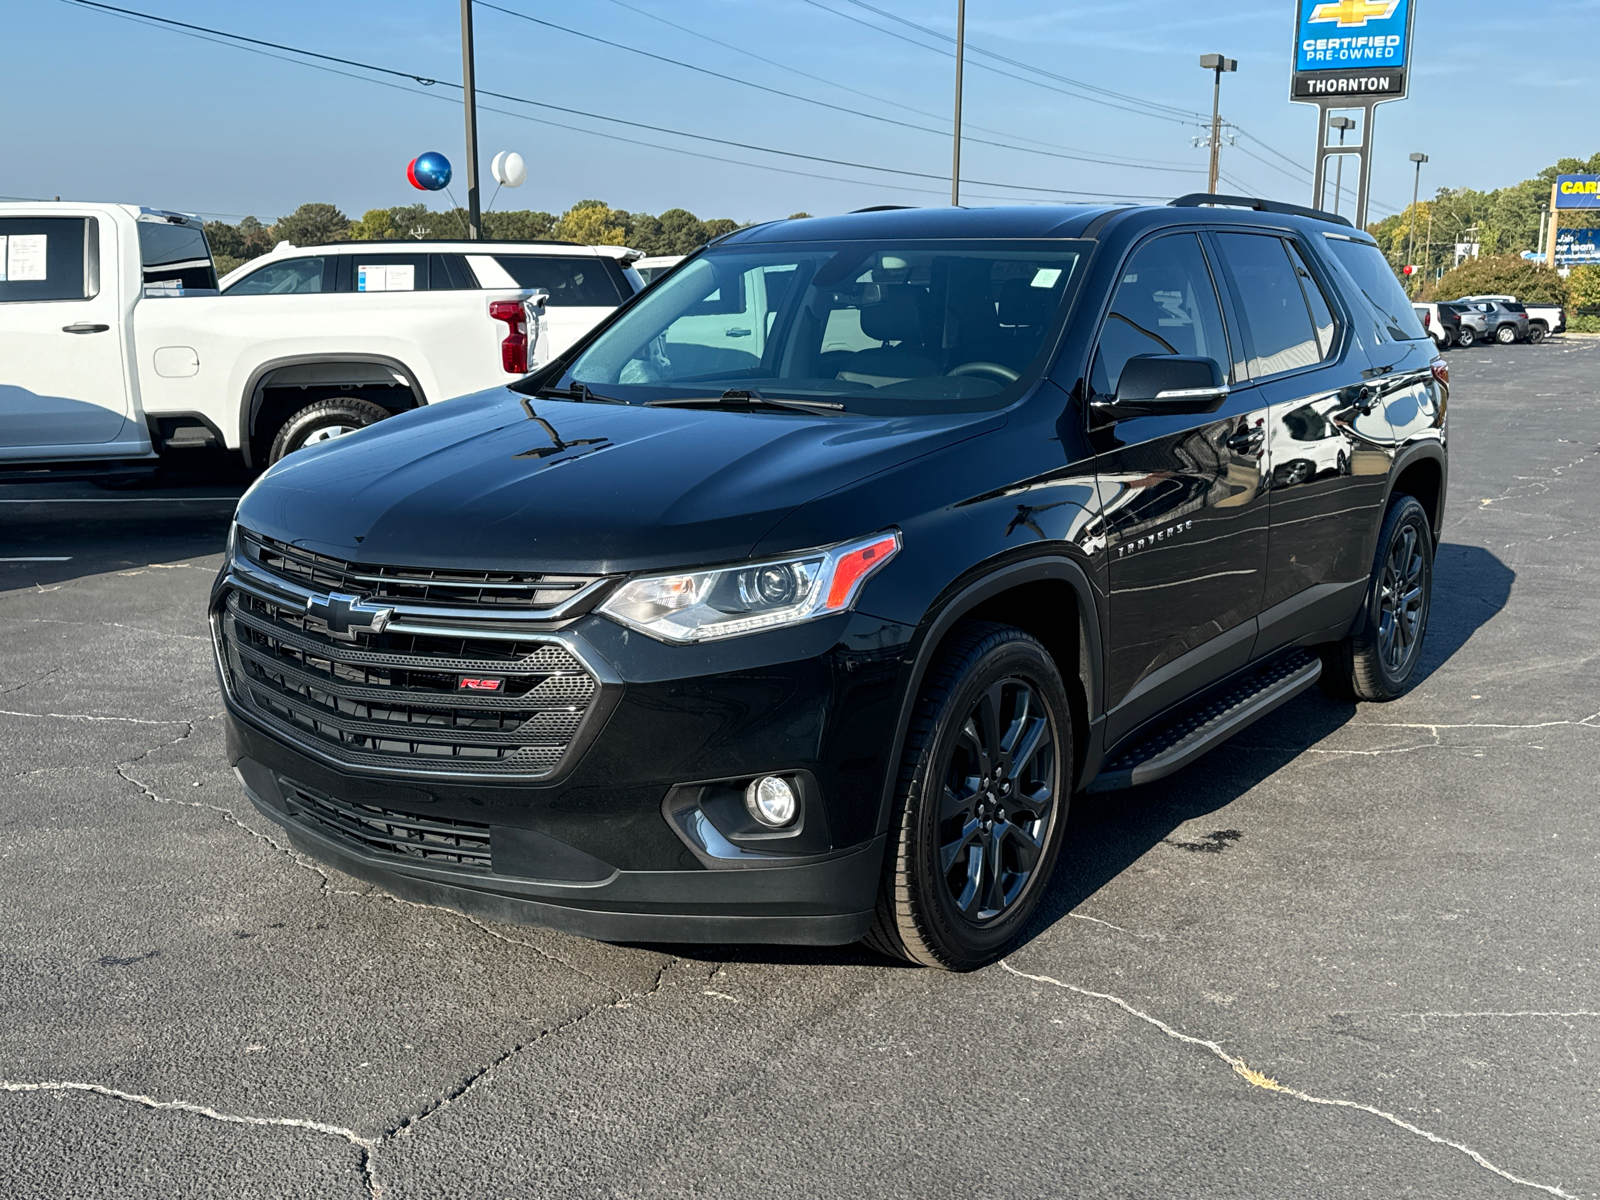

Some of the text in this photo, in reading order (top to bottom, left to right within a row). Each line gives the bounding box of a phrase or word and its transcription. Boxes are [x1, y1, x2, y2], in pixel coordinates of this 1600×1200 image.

[1302, 35, 1400, 51] CERTIFIED
[1306, 47, 1394, 62] PRE-OWNED
[1307, 77, 1390, 93] THORNTON
[1557, 234, 1574, 243] Join
[1570, 243, 1595, 252] team
[1118, 519, 1193, 557] TRAVERSE
[460, 678, 501, 690] RS
